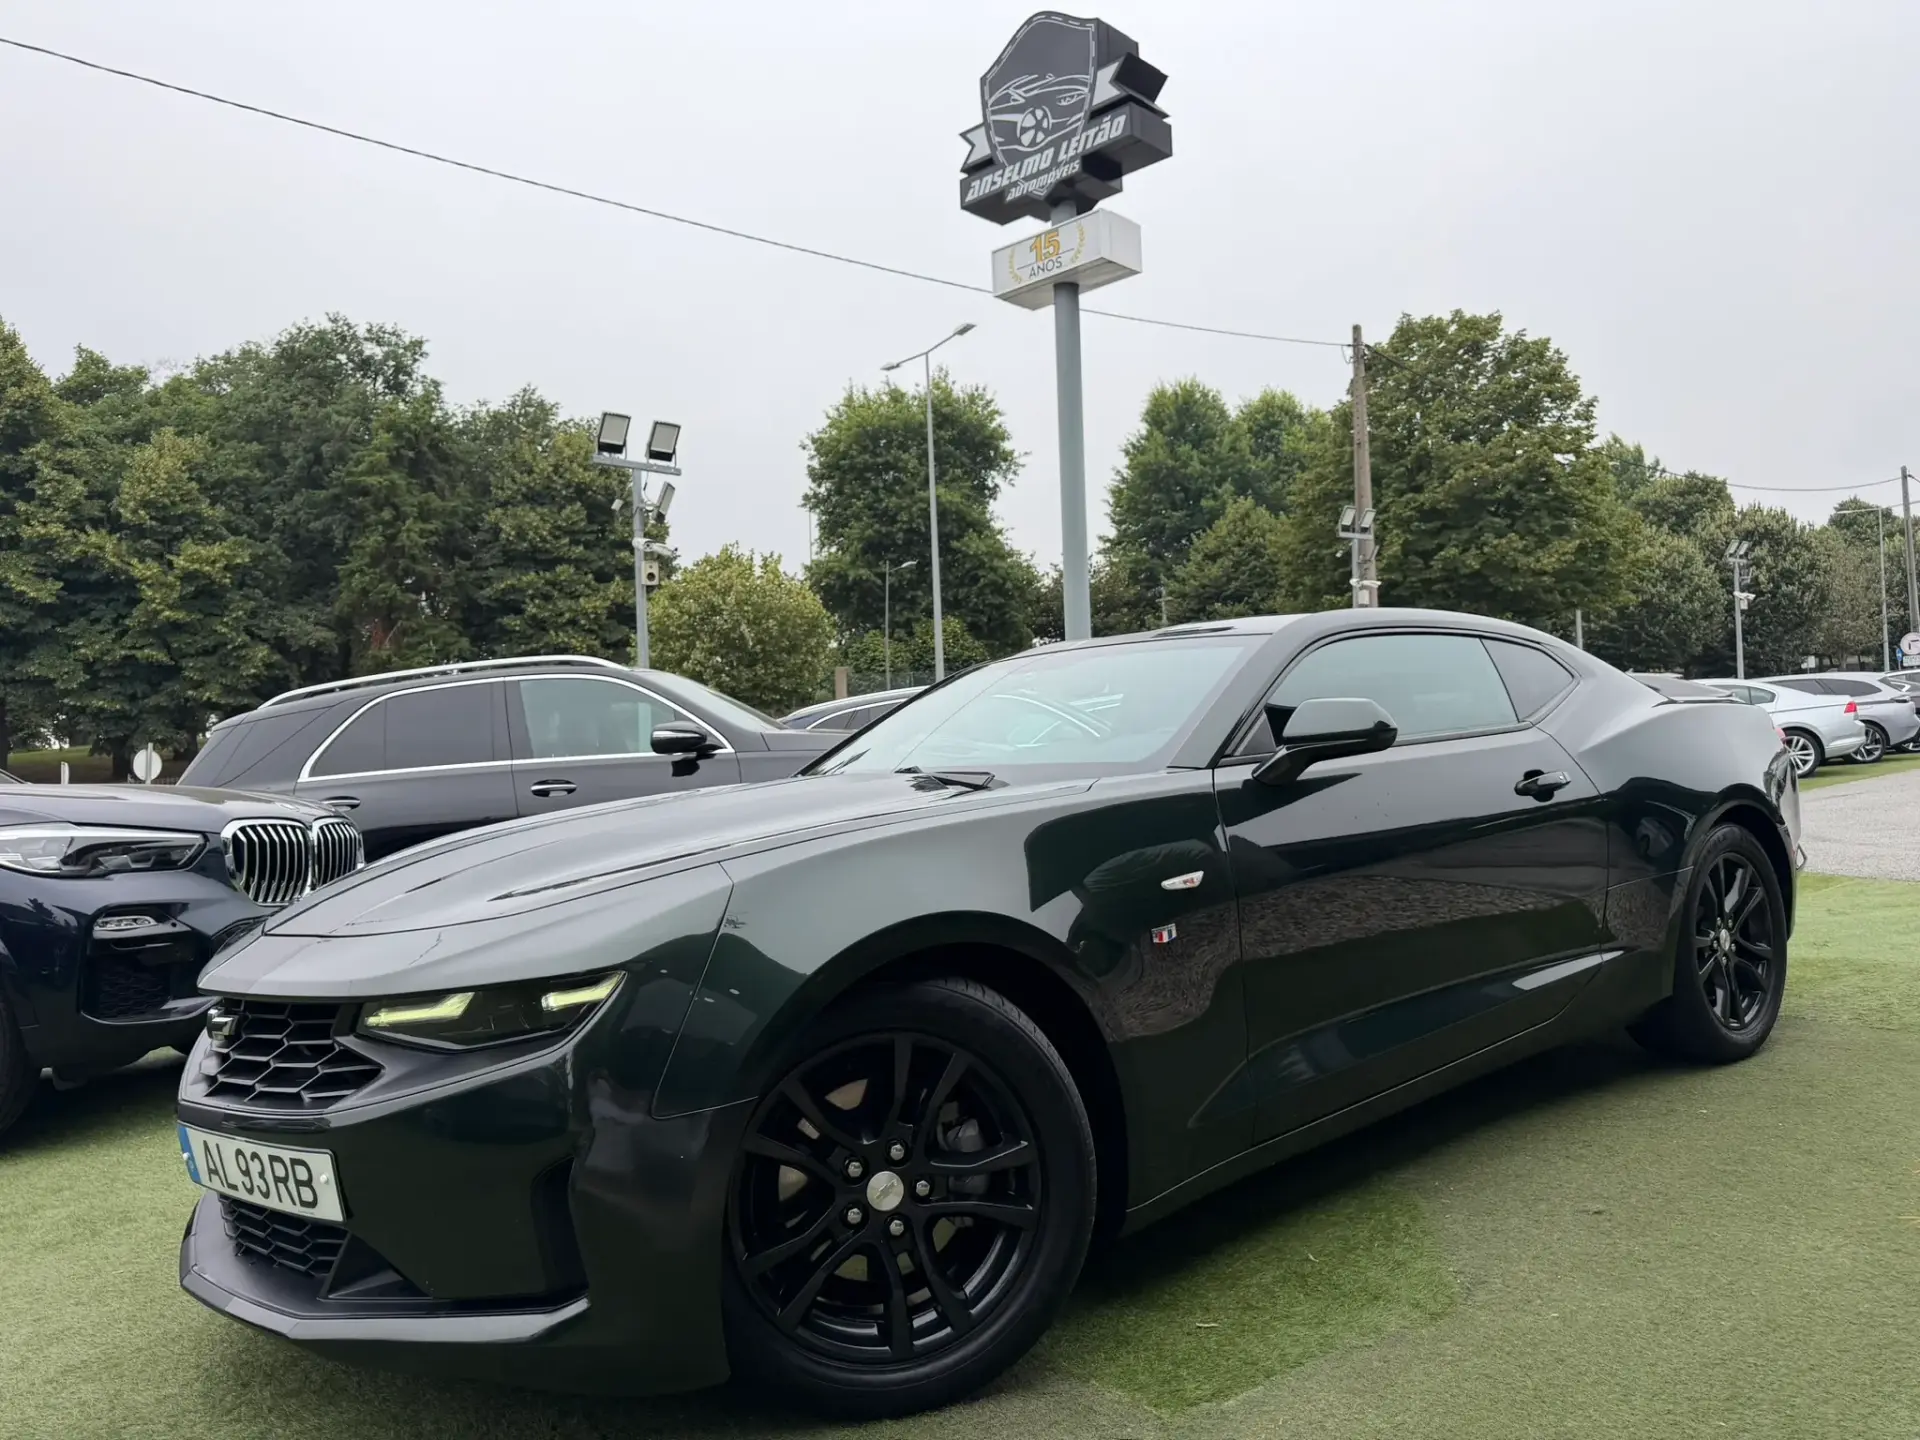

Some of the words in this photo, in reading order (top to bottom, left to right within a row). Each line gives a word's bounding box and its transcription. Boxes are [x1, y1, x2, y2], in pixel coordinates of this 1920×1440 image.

[1057, 114, 1127, 162] LEITÃO
[1029, 228, 1061, 263] 15
[1029, 255, 1063, 279] ANOS
[202, 1139, 318, 1209] AL93RB
